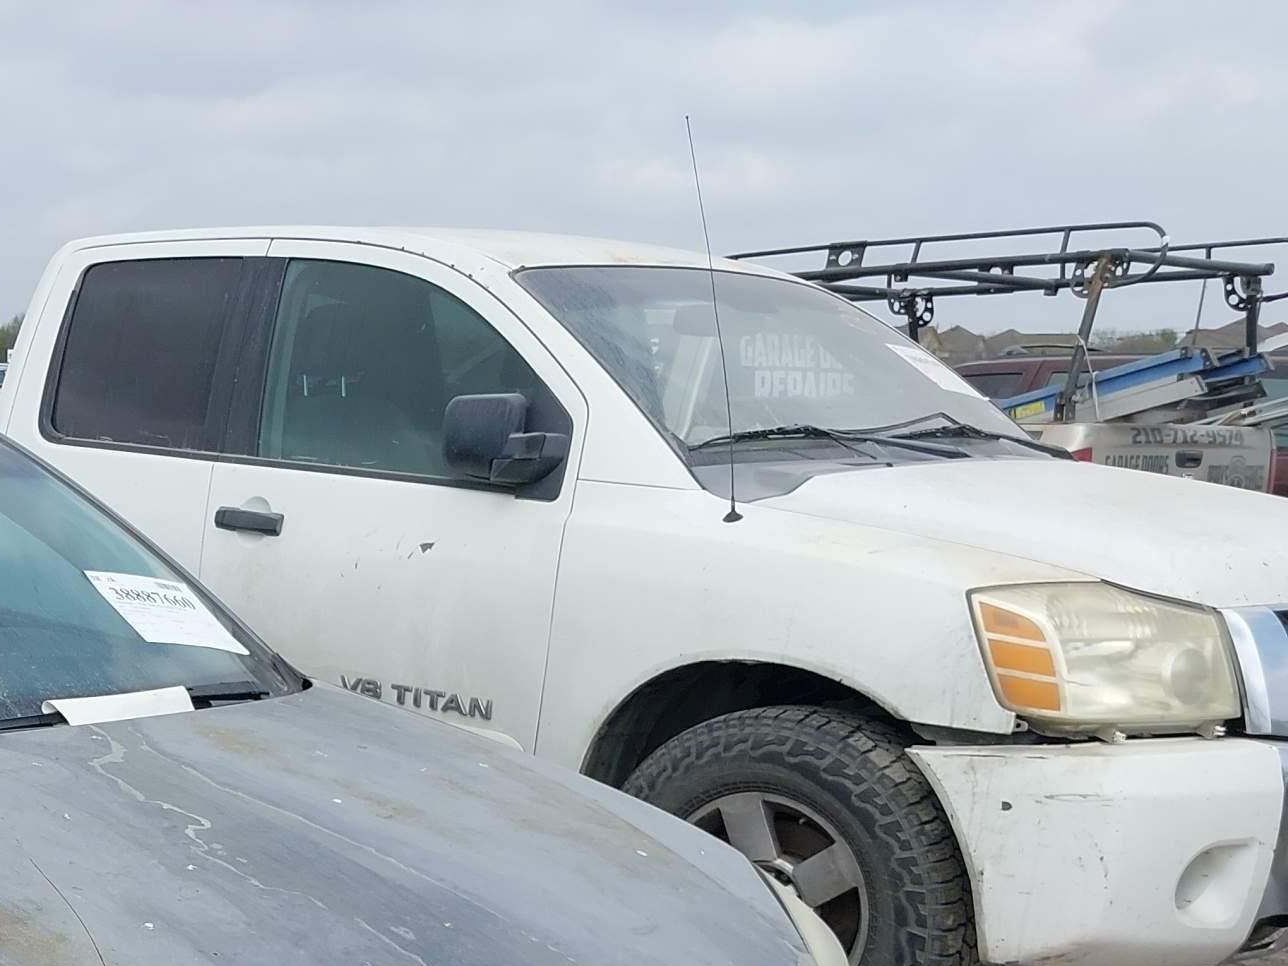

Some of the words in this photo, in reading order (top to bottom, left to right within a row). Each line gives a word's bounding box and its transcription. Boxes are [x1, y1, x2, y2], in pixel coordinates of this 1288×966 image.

[739, 332, 816, 369] GARAGE
[108, 586, 197, 610] 38887660
[340, 674, 383, 700] V8
[391, 683, 493, 721] TITAN
